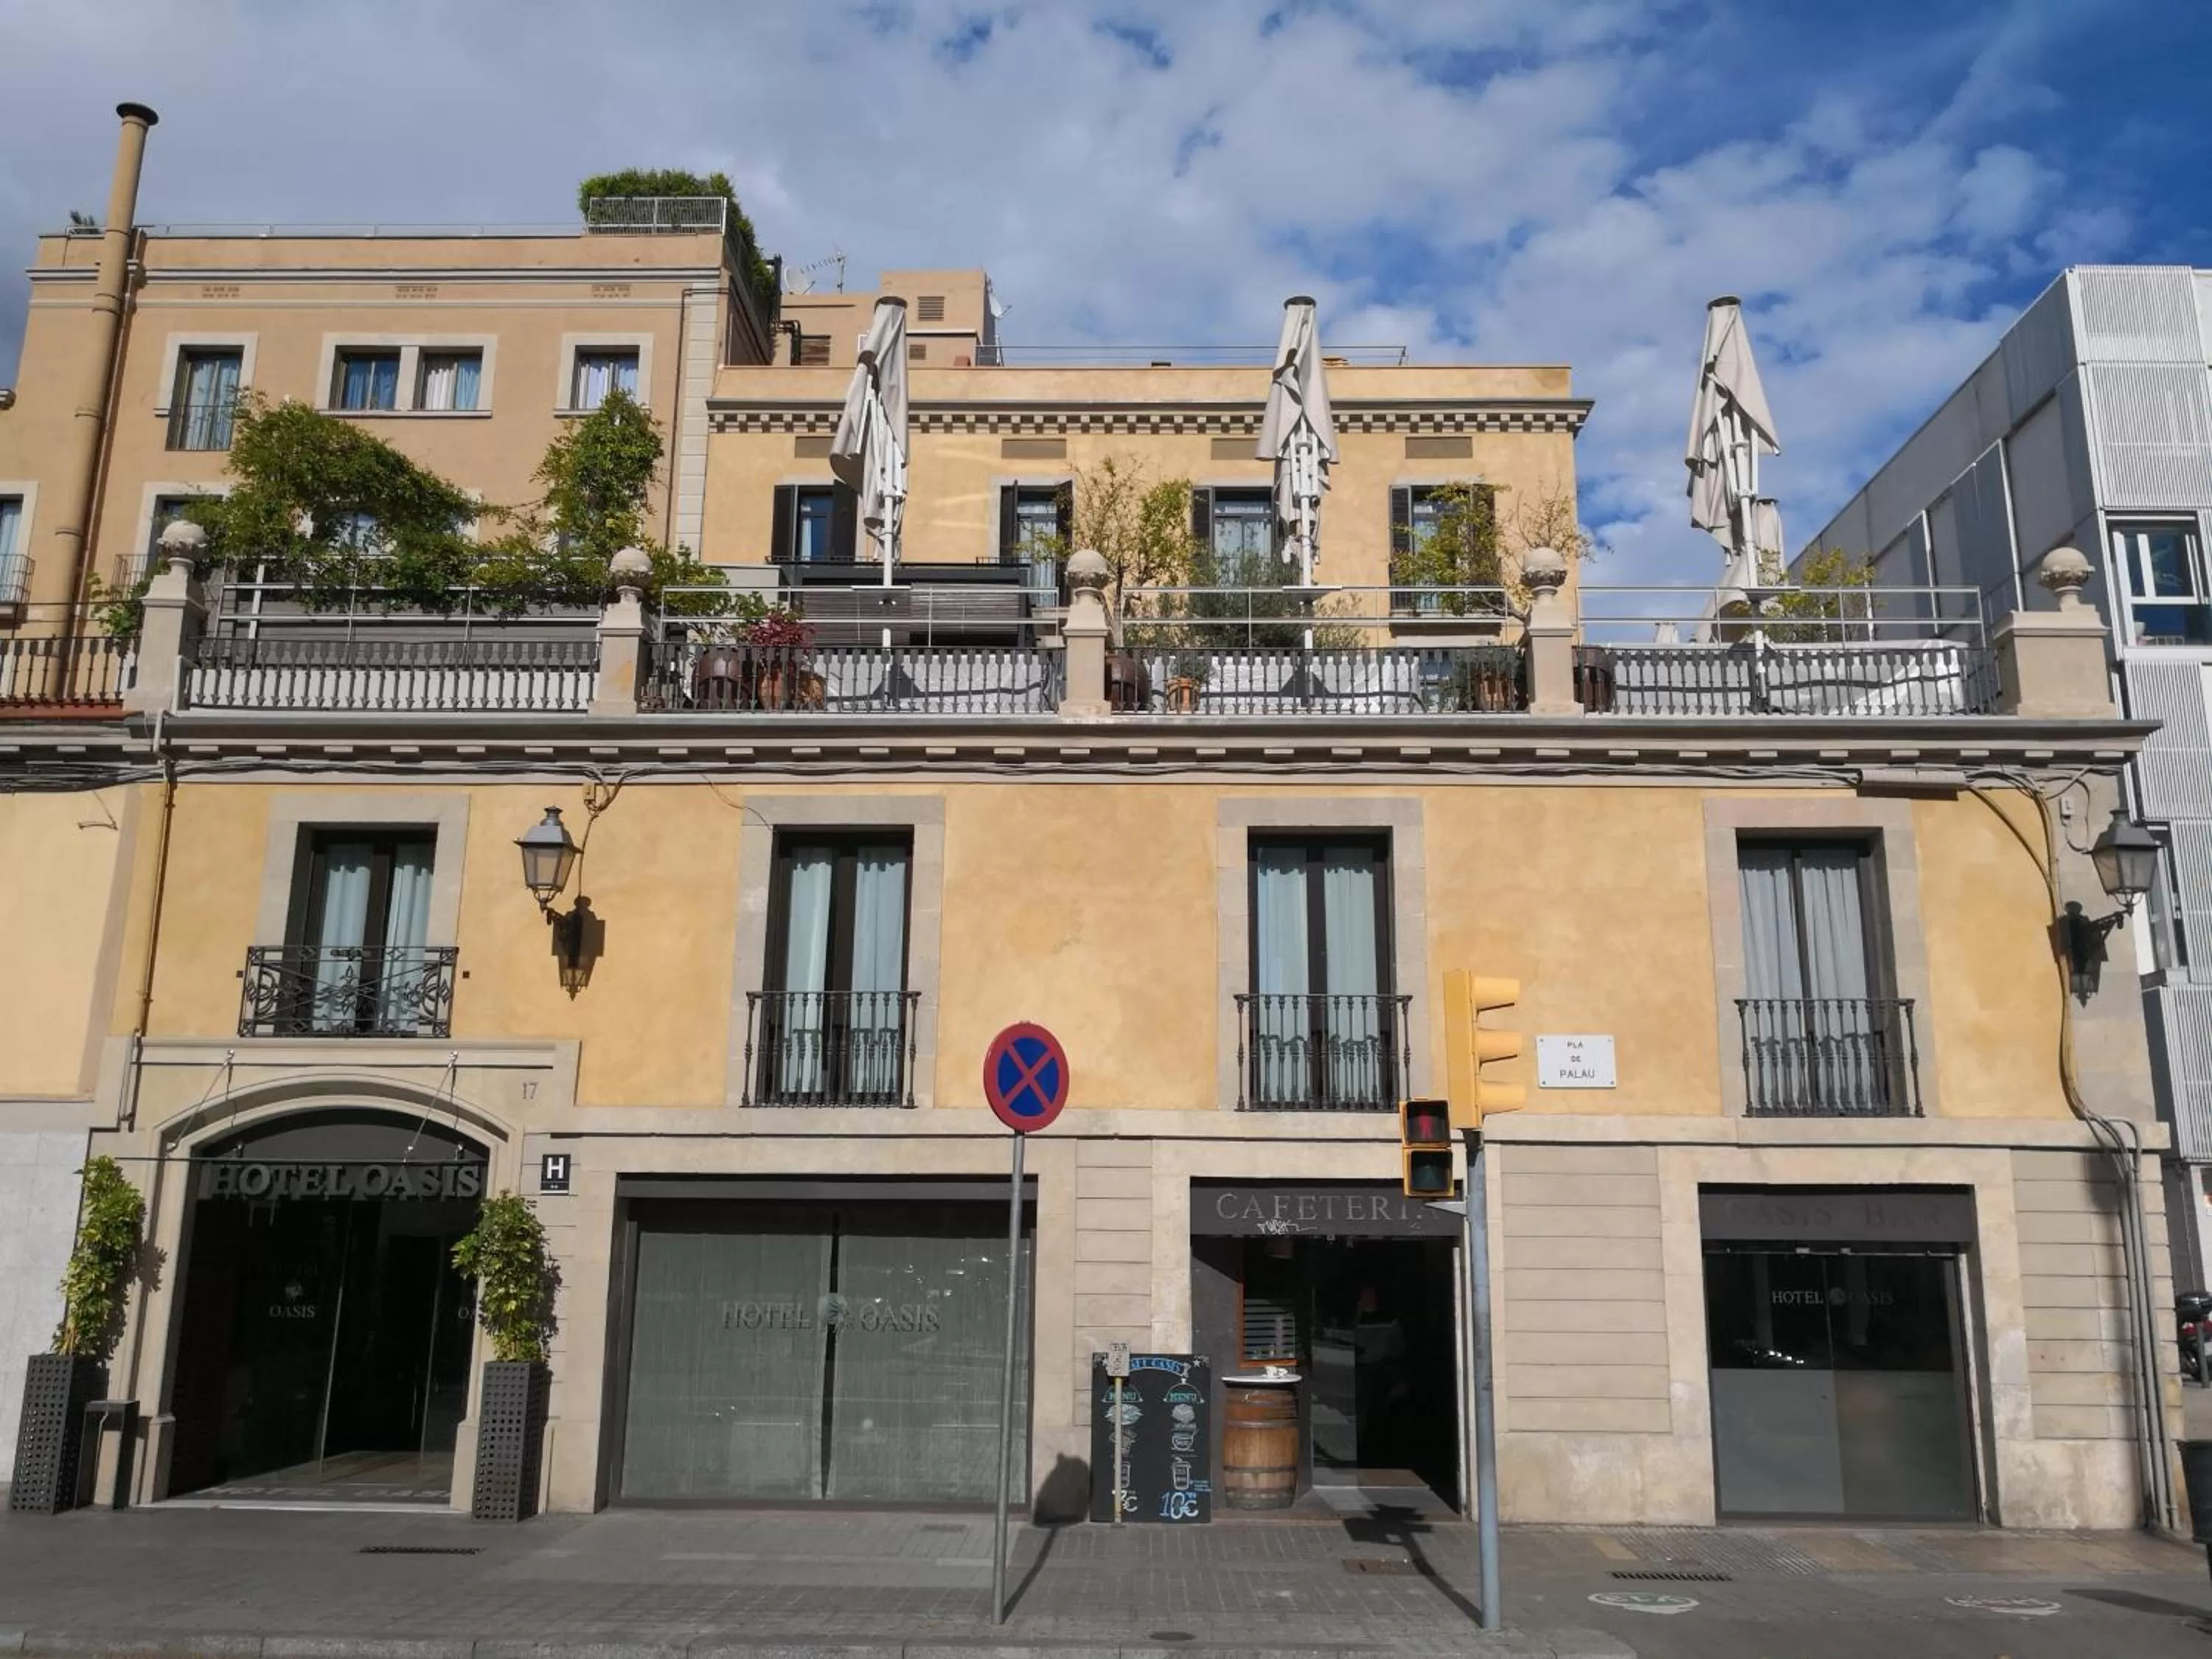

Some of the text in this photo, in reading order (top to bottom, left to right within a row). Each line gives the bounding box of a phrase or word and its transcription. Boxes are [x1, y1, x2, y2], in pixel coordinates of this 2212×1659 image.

[1567, 1040, 1584, 1048] PLA
[1559, 1069, 1596, 1079] PALAU
[522, 1082, 538, 1100] 17
[546, 1157, 565, 1179] H
[208, 1164, 480, 1197] HOTEL OASIS
[1217, 1193, 1439, 1220] CAFETERI
[1771, 1291, 1823, 1304] HOTEL
[268, 1304, 316, 1318] OASIS
[723, 1301, 938, 1331] HOTEL OASIS
[1160, 1492, 1199, 1520] 10€
